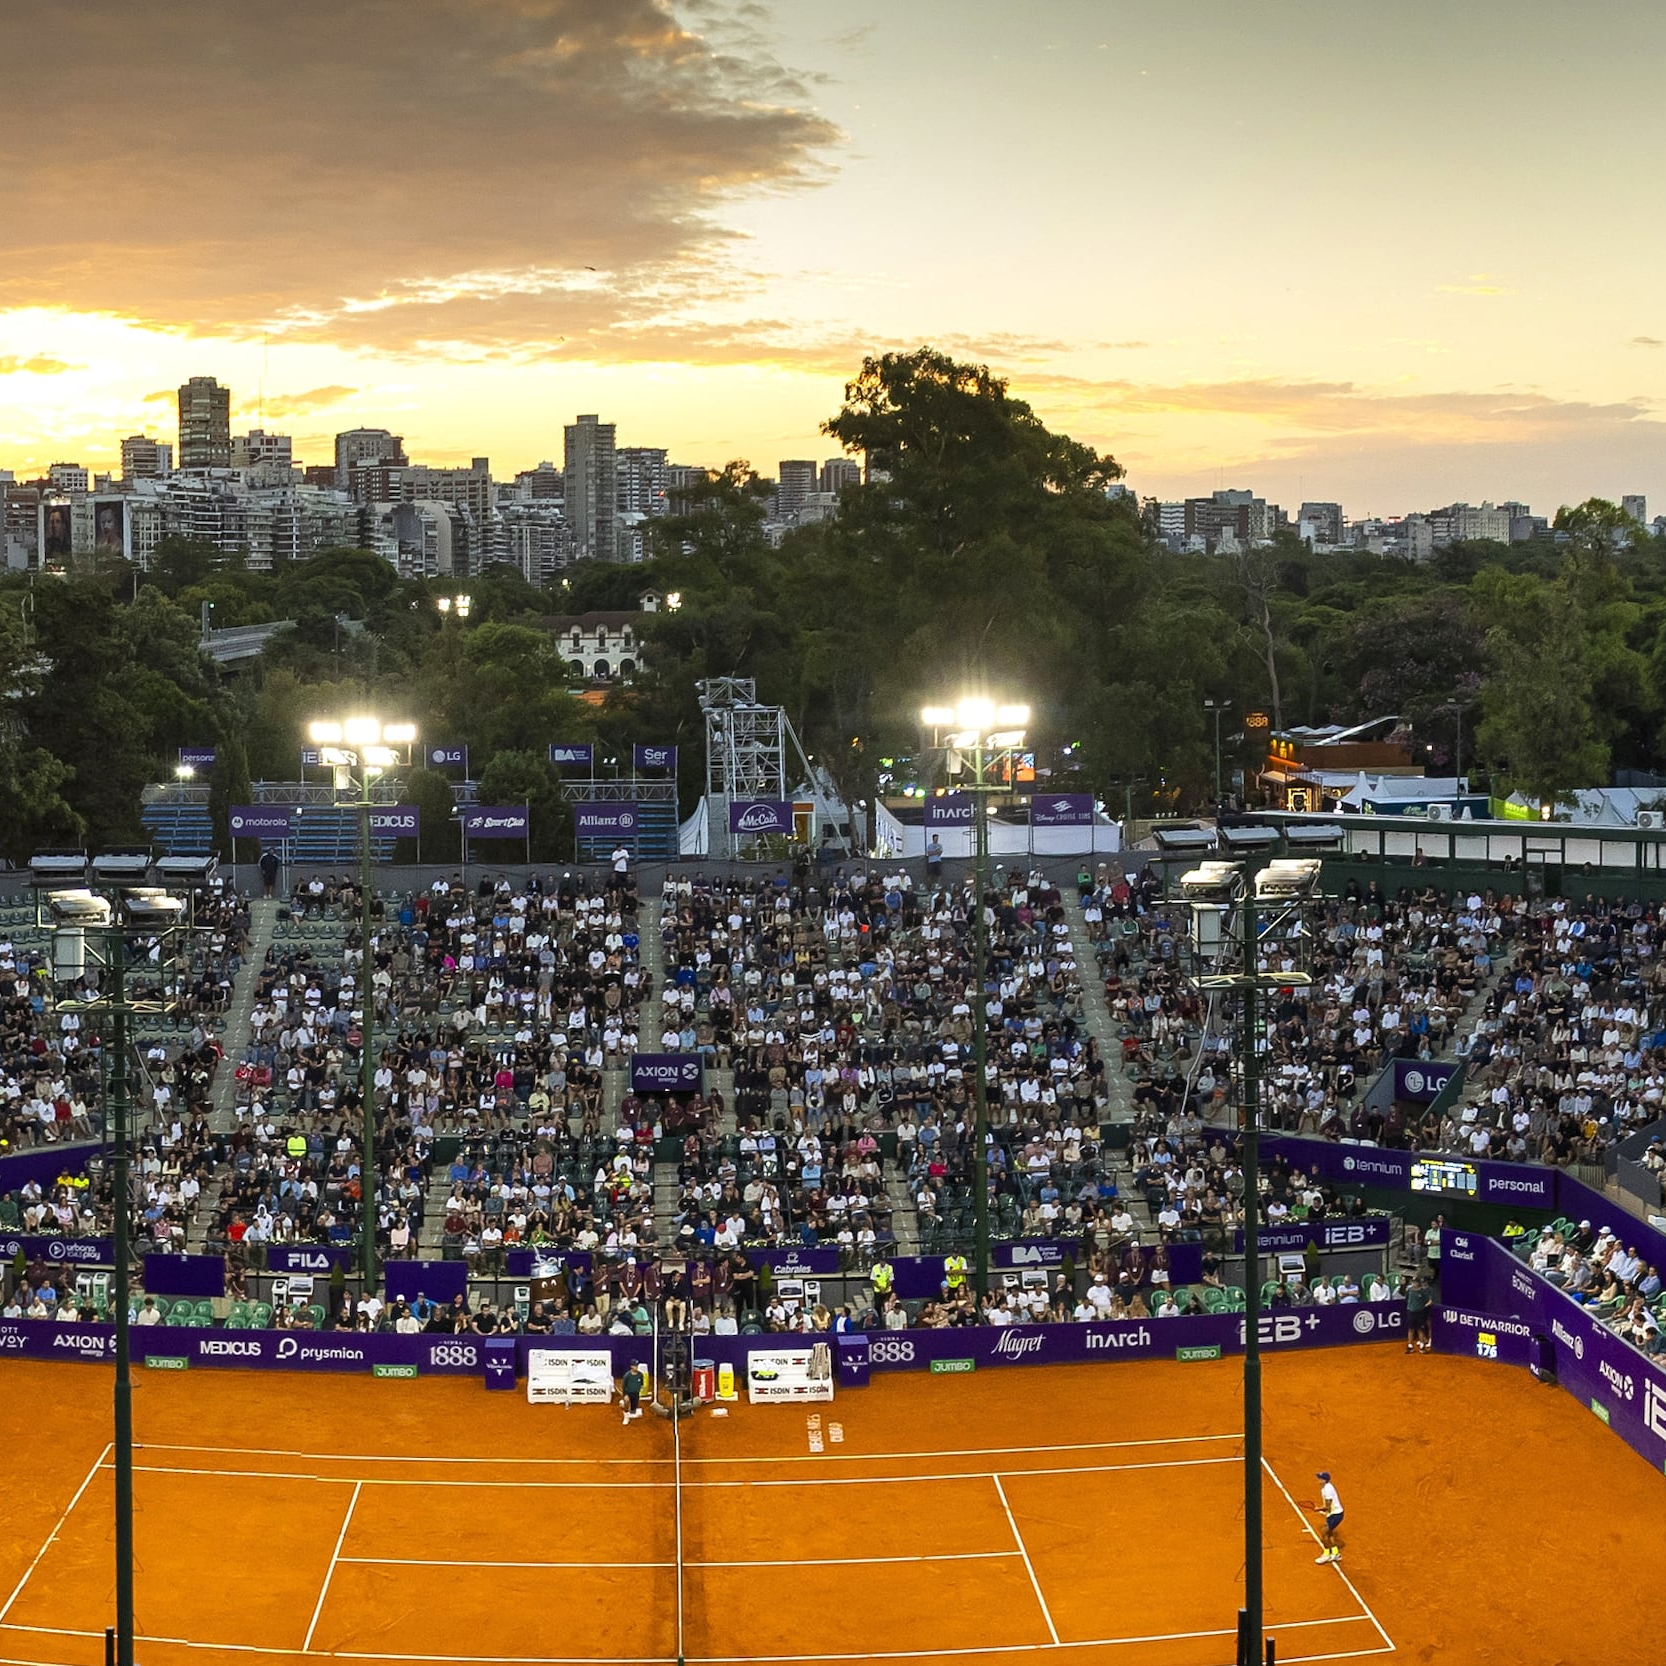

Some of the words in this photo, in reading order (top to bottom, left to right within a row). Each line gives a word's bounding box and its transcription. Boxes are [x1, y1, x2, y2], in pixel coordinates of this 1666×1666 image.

[446, 751, 461, 760] LG
[644, 748, 667, 760] Ser
[245, 817, 287, 827] motorola
[579, 815, 617, 826] Allianz
[635, 1066, 678, 1077] AXION
[1427, 1076, 1448, 1091] LG
[1489, 1178, 1545, 1194] personal
[288, 1253, 329, 1268] FILA
[1012, 1246, 1043, 1264] BA
[773, 1264, 812, 1274] Cabrales
[1377, 1311, 1401, 1328] LG
[1460, 1313, 1531, 1337] BETWARRIOR
[1551, 1318, 1575, 1350] Allianz
[52, 1334, 105, 1350] AXION
[200, 1340, 261, 1357] MEDICUS
[990, 1328, 1047, 1361] Magret
[300, 1346, 364, 1361] prysmian
[430, 1345, 477, 1366] 1888
[868, 1341, 915, 1363] 1888
[1182, 1349, 1217, 1359] JUMBO
[1476, 1344, 1498, 1358] 176
[148, 1359, 184, 1369] JUMBO
[377, 1366, 413, 1377] JUMBO
[933, 1362, 971, 1373] JUMBO
[1599, 1359, 1623, 1390] AXION
[770, 1387, 790, 1395] ISDIN
